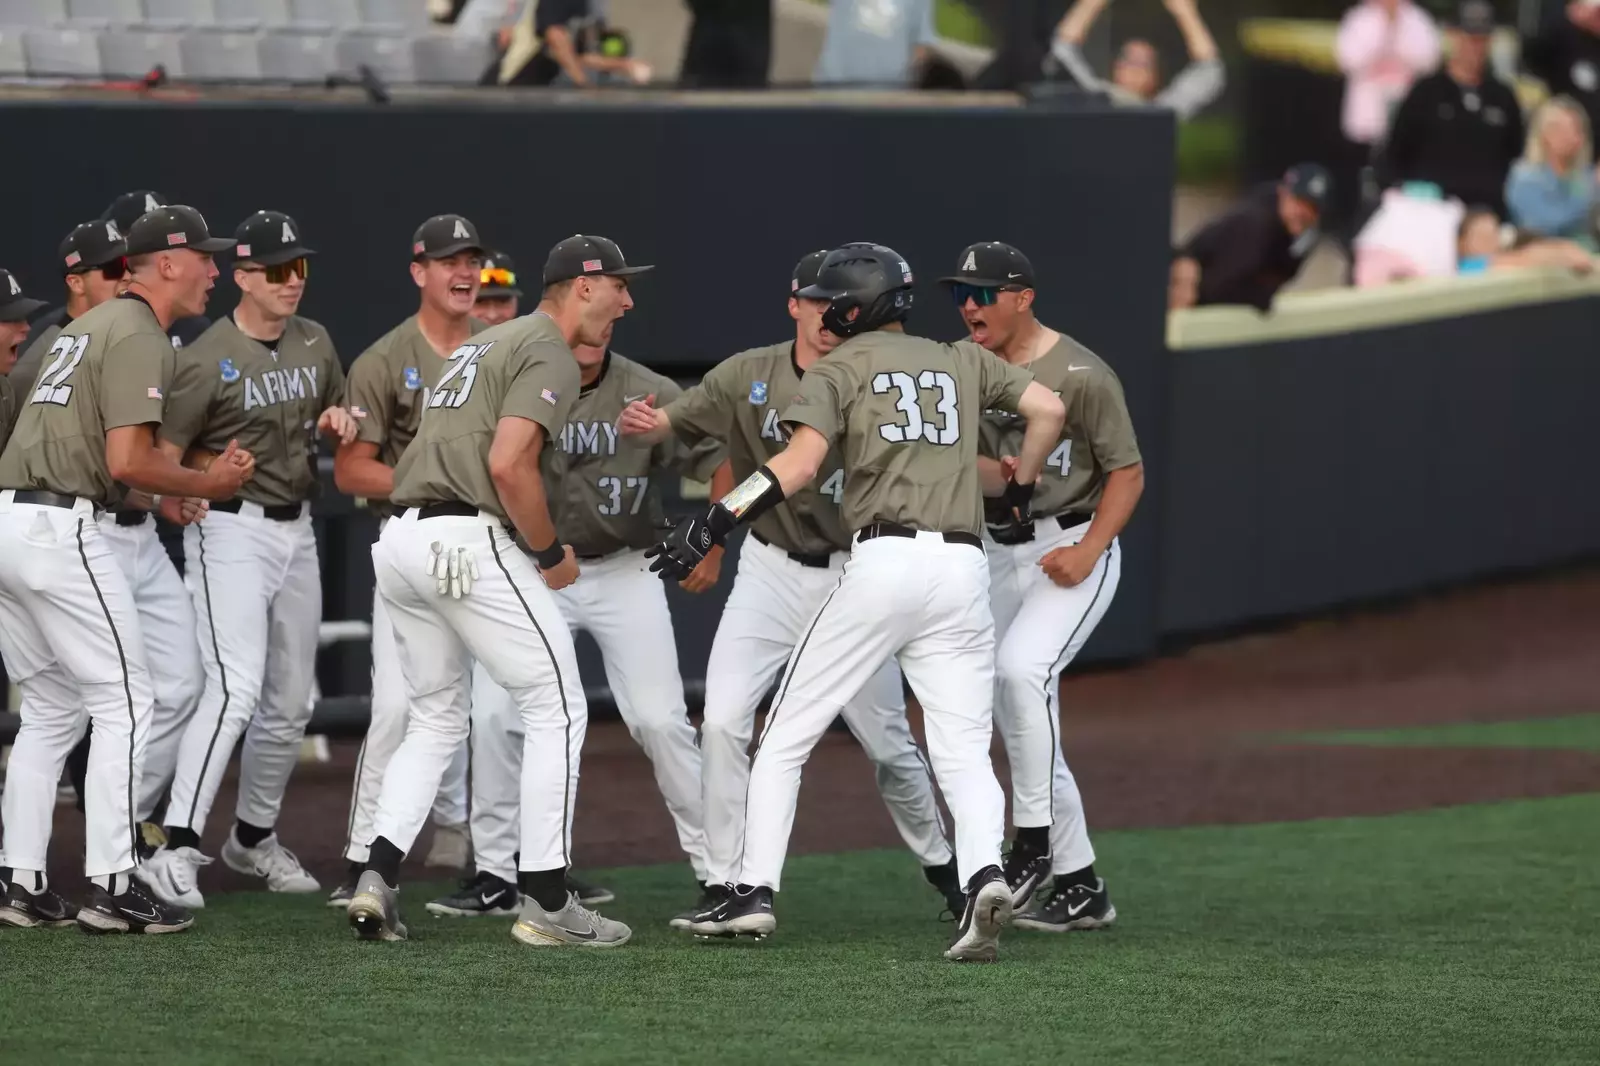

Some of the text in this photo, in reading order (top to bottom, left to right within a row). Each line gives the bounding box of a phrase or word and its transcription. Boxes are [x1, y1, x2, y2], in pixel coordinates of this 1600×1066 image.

[105, 219, 122, 242] A
[281, 221, 296, 243] A
[453, 219, 470, 239] A
[962, 250, 977, 271] A
[7, 274, 22, 296] A
[30, 333, 90, 407] 22
[428, 340, 498, 410] 25
[242, 365, 319, 412] ARMY
[871, 370, 961, 446] 33
[597, 475, 649, 516] 37
